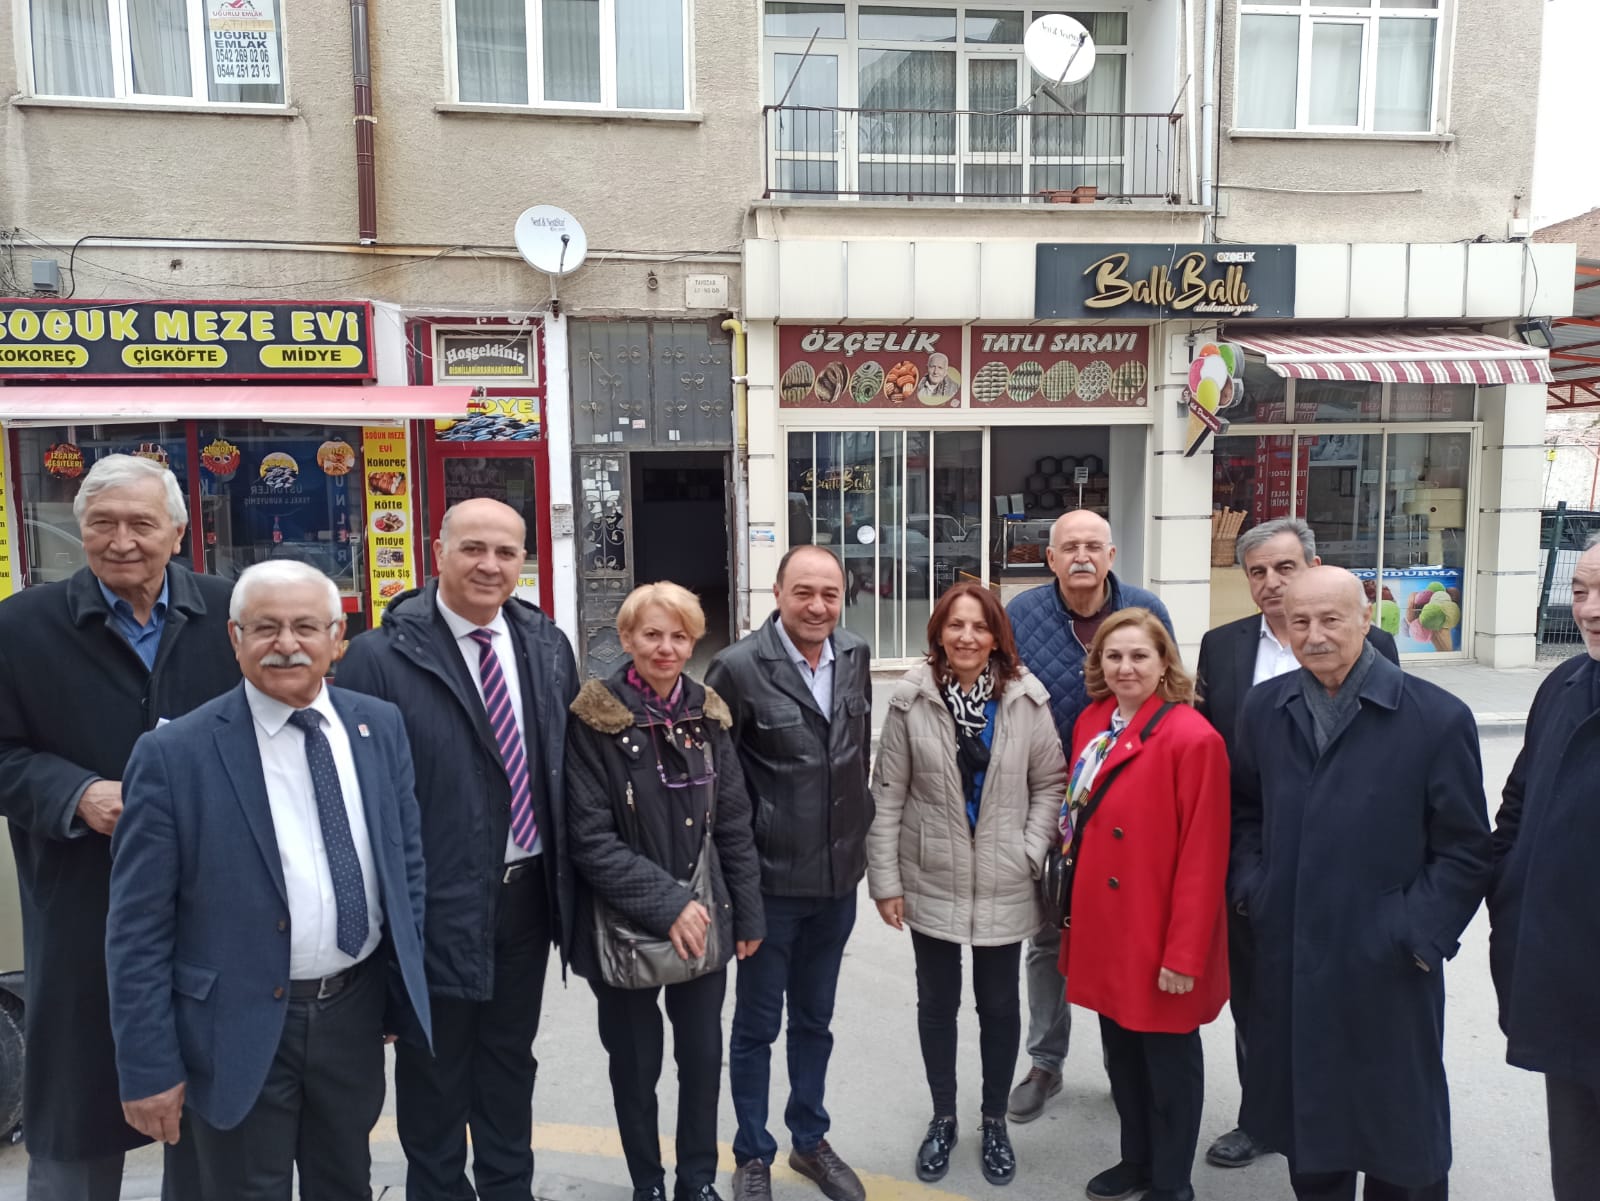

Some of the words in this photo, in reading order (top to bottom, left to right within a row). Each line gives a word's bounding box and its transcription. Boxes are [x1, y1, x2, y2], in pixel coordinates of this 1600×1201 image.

[215, 40, 267, 48] EMLAK
[216, 49, 233, 62] 0542
[235, 49, 248, 62] 269
[250, 50, 259, 62] 02
[260, 50, 269, 62] 06
[217, 64, 234, 77] 0544
[237, 64, 249, 77] 251
[251, 65, 260, 77] 23
[262, 65, 271, 77] 13
[154, 310, 275, 341] MEZE
[801, 329, 940, 356] ÖZÇELİK
[982, 333, 1044, 352] TATLI
[1050, 333, 1138, 352] SARAYI
[281, 346, 342, 362] MİDYE
[446, 343, 526, 364] Hoşgeldiniz
[367, 457, 406, 468] Kokoreç
[374, 500, 402, 510] Köfte
[376, 537, 404, 546] Midye
[373, 569, 395, 578] Tavuk
